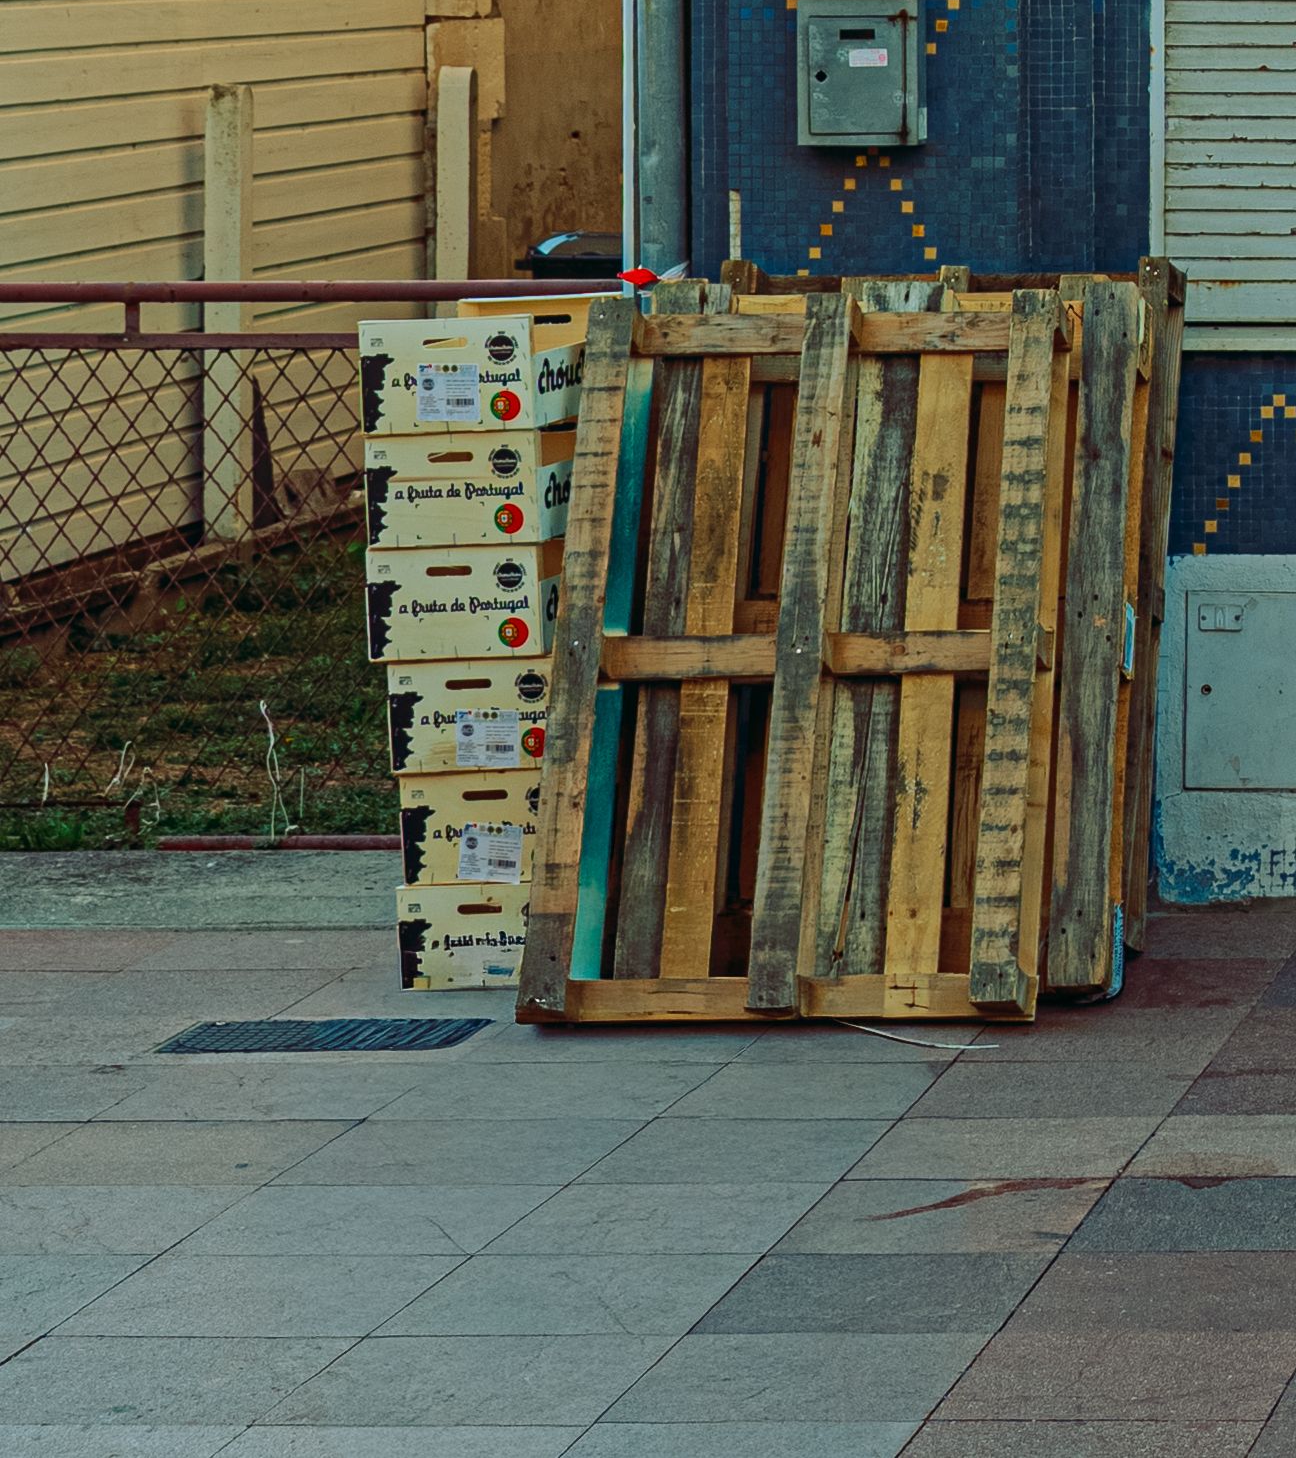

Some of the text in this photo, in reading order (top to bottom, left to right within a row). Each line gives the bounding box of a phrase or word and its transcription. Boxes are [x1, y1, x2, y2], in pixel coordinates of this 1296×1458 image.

[407, 485, 443, 503] fruta
[446, 484, 462, 498] de
[464, 481, 525, 500] Portugal
[411, 599, 448, 617] fruta
[450, 597, 466, 612] de
[469, 595, 530, 614] Portugal
